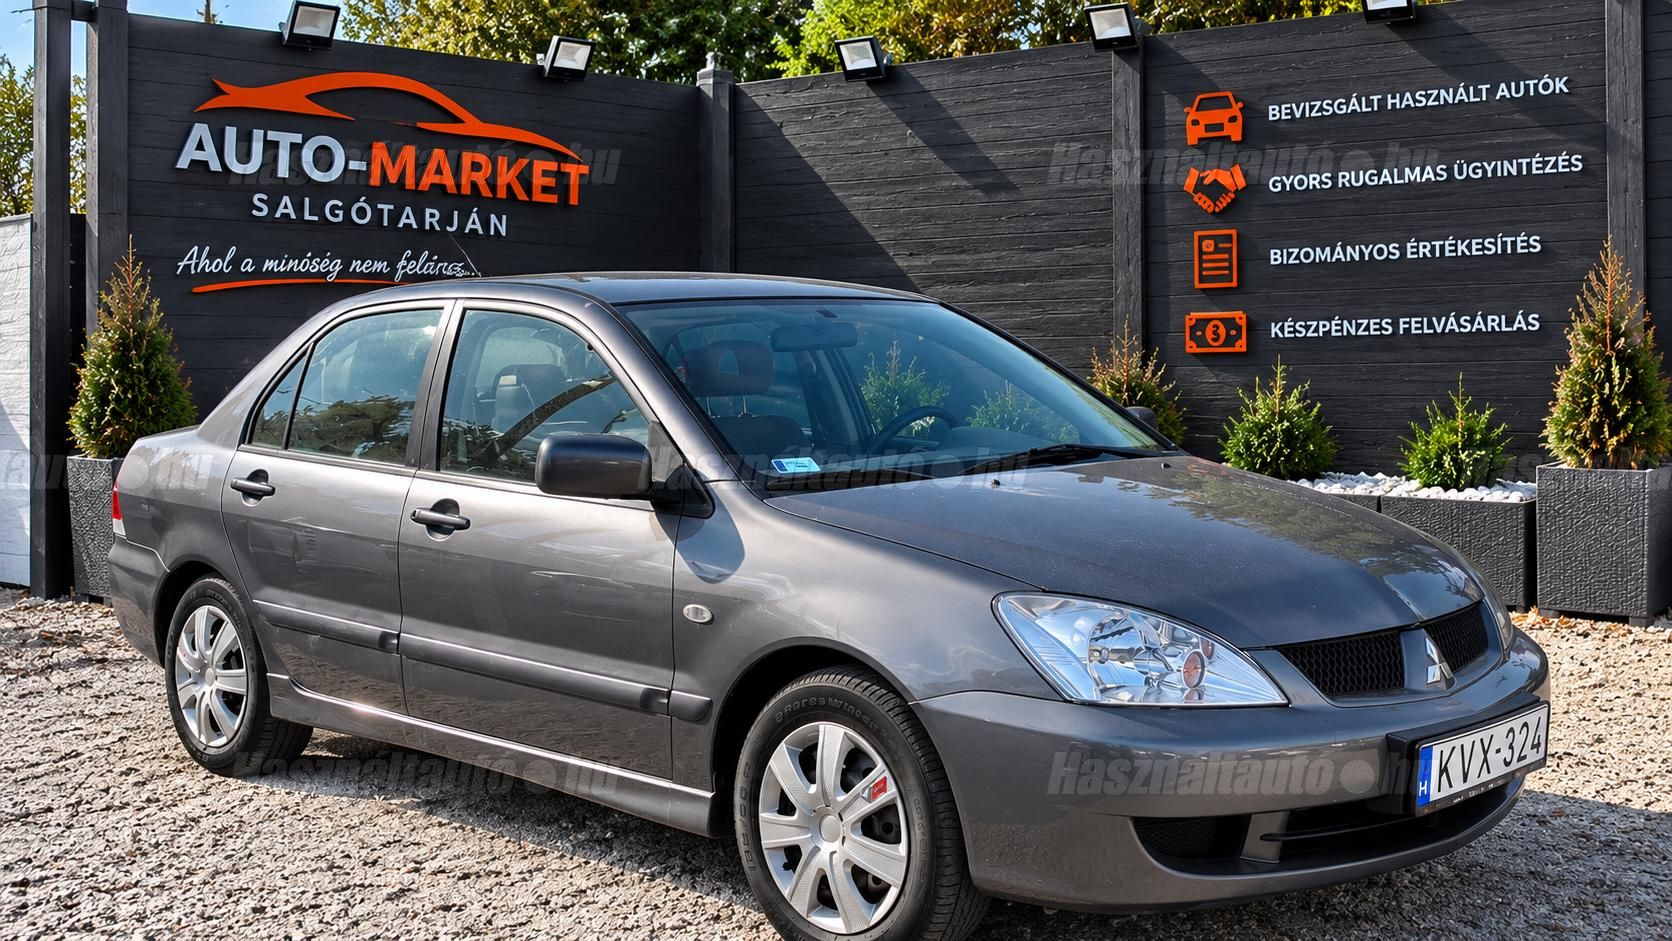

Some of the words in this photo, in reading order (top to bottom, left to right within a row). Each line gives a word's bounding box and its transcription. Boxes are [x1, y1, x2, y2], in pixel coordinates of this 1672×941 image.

[1267, 95, 1382, 121] BEVIZSGÁLT
[1386, 83, 1491, 110] HASZNÁLT
[1495, 74, 1570, 100] AUTÓK
[175, 122, 590, 207] AUTO-MARKET
[1268, 172, 1333, 193] GYORS
[1337, 164, 1448, 188] RUGALMAS
[1453, 151, 1583, 181] ÜGYINTÉZÉS
[251, 193, 508, 237] SALGÓTARJÁN
[176, 245, 236, 276] Ahol
[240, 258, 256, 273] a
[348, 259, 391, 275] nem
[1269, 238, 1401, 265] BIZOMÁNYOS
[1406, 231, 1542, 260] ÉRTÉKESÍTÉS
[1270, 315, 1393, 338] KÉSZPÉNZES
[1399, 309, 1541, 335] FELVÁSÁRLÁS
[1437, 716, 1542, 793] KVX-324
[1418, 780, 1428, 797] H
